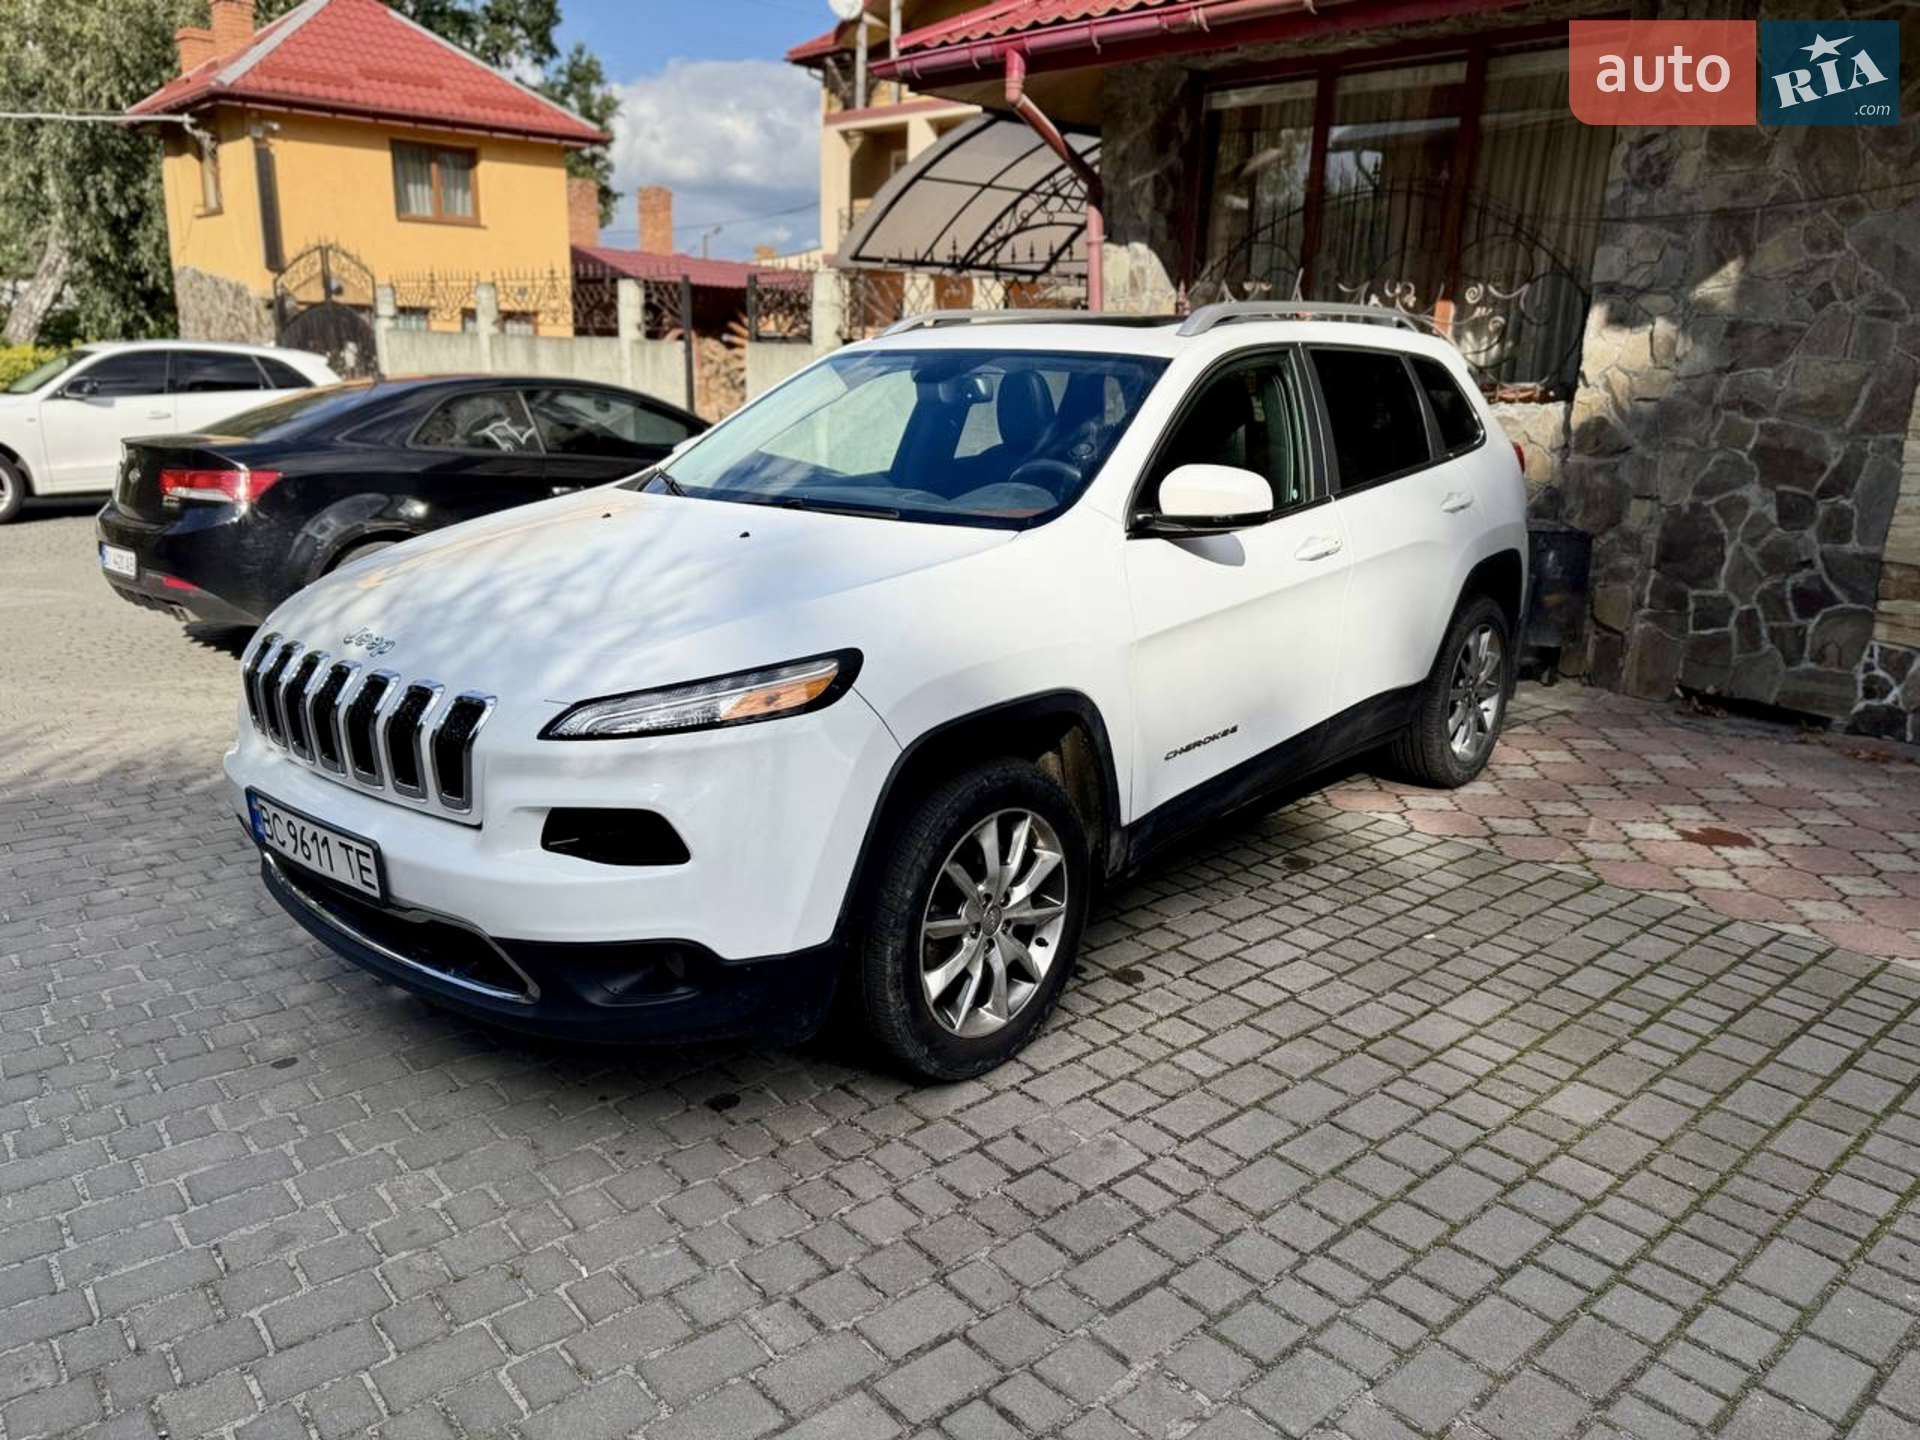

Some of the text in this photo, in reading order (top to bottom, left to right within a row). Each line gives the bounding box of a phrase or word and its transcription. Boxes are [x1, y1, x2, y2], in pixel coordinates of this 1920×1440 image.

[343, 626, 396, 658] Jeep
[1164, 724, 1238, 760] CHEROKEE
[338, 841, 377, 891] TE
